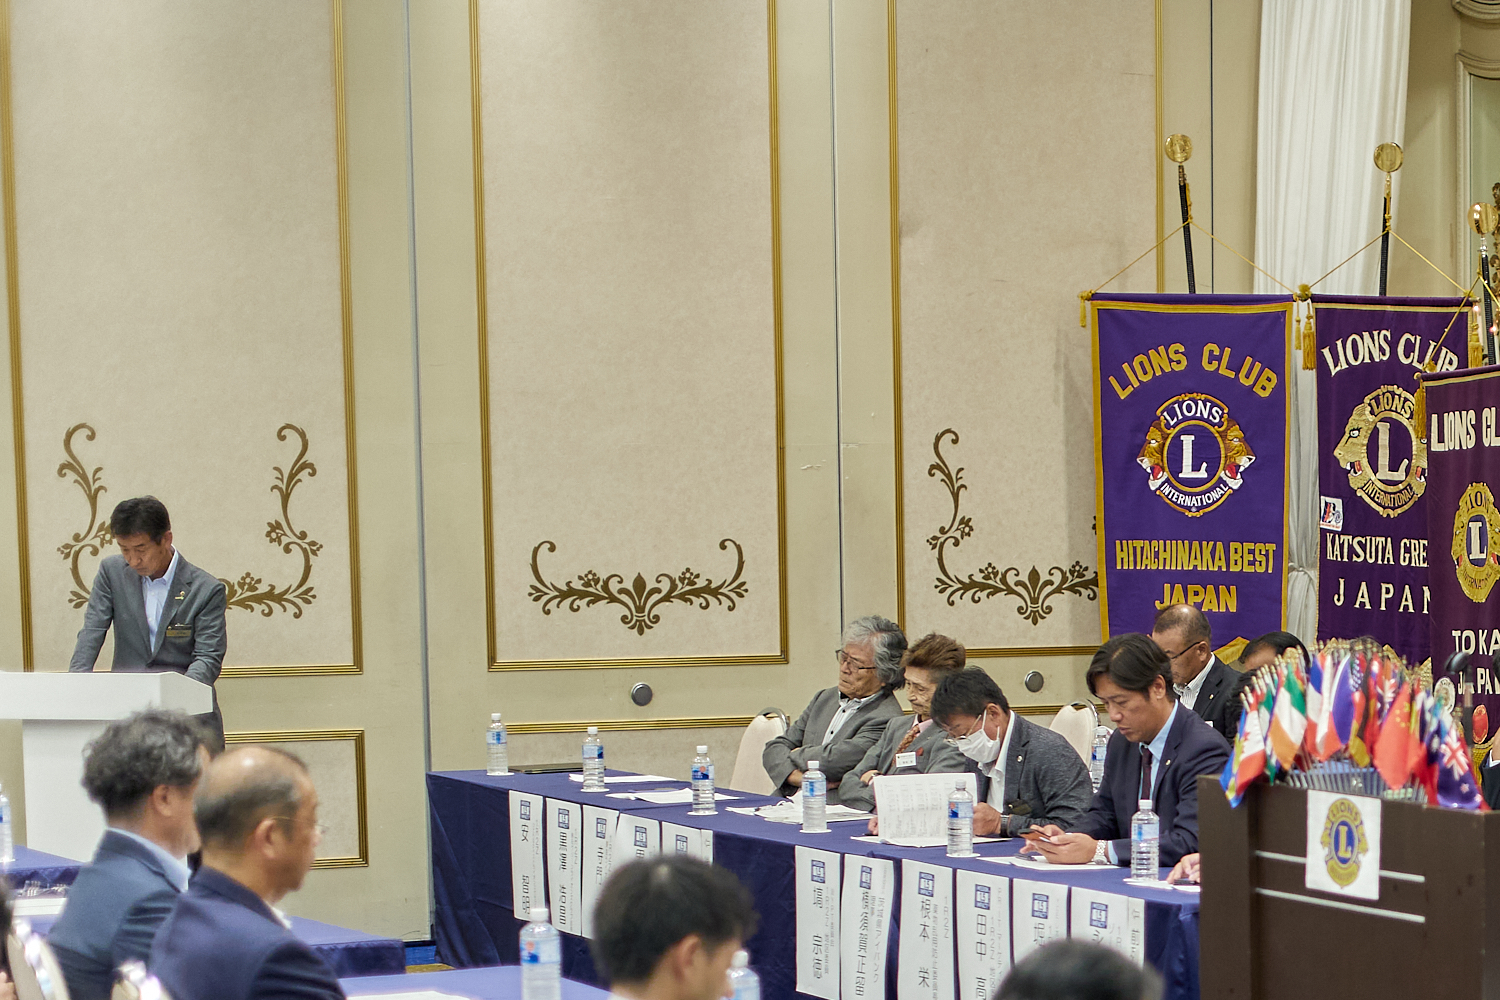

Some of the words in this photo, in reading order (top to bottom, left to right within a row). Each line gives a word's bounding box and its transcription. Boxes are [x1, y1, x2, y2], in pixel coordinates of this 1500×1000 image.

[1108, 342, 1188, 399] LIONS
[1202, 342, 1278, 398] CLUB
[1320, 329, 1391, 377] LIONS
[1162, 400, 1223, 425] LIONS
[1370, 392, 1414, 418] LIONS
[1430, 409, 1476, 451] LIONS
[1178, 434, 1208, 478] L
[1376, 422, 1409, 480] L
[1160, 482, 1229, 507] INTERNATIONAL
[1362, 480, 1414, 507] INTERNATIONAL
[1115, 540, 1227, 571] HITACHINAKA
[1229, 542, 1276, 573] BEST
[1326, 532, 1395, 564] KATSUTA
[1399, 538, 1429, 568] GRE
[1468, 521, 1487, 560] L
[1154, 583, 1237, 612] JAPAN
[1331, 801, 1359, 822] LIONS
[920, 897, 931, 942] 根本
[976, 914, 987, 961] 田中
[918, 966, 930, 988] 栄
